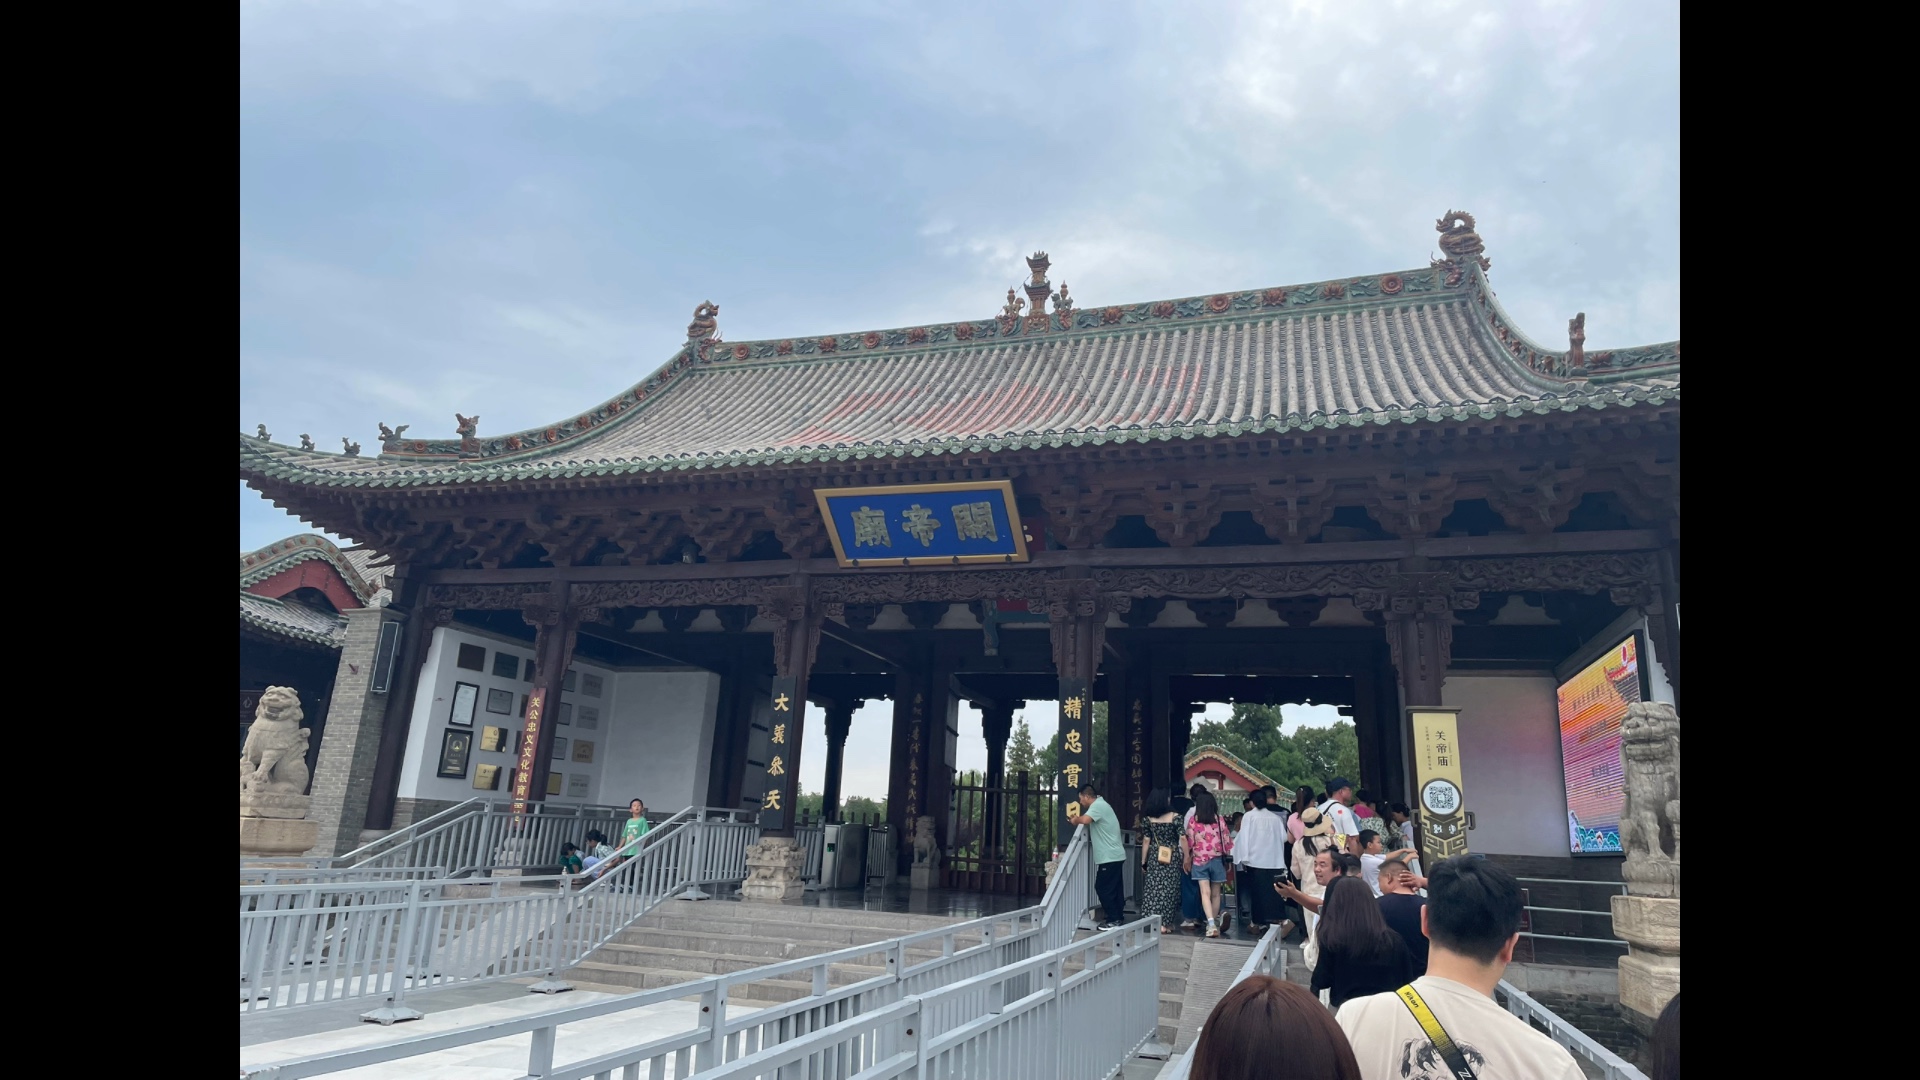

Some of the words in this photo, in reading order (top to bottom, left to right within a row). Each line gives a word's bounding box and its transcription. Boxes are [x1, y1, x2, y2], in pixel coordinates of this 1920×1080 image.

[1435, 731, 1448, 766] 关帝庙
[1404, 991, 1419, 1008] Nikon
